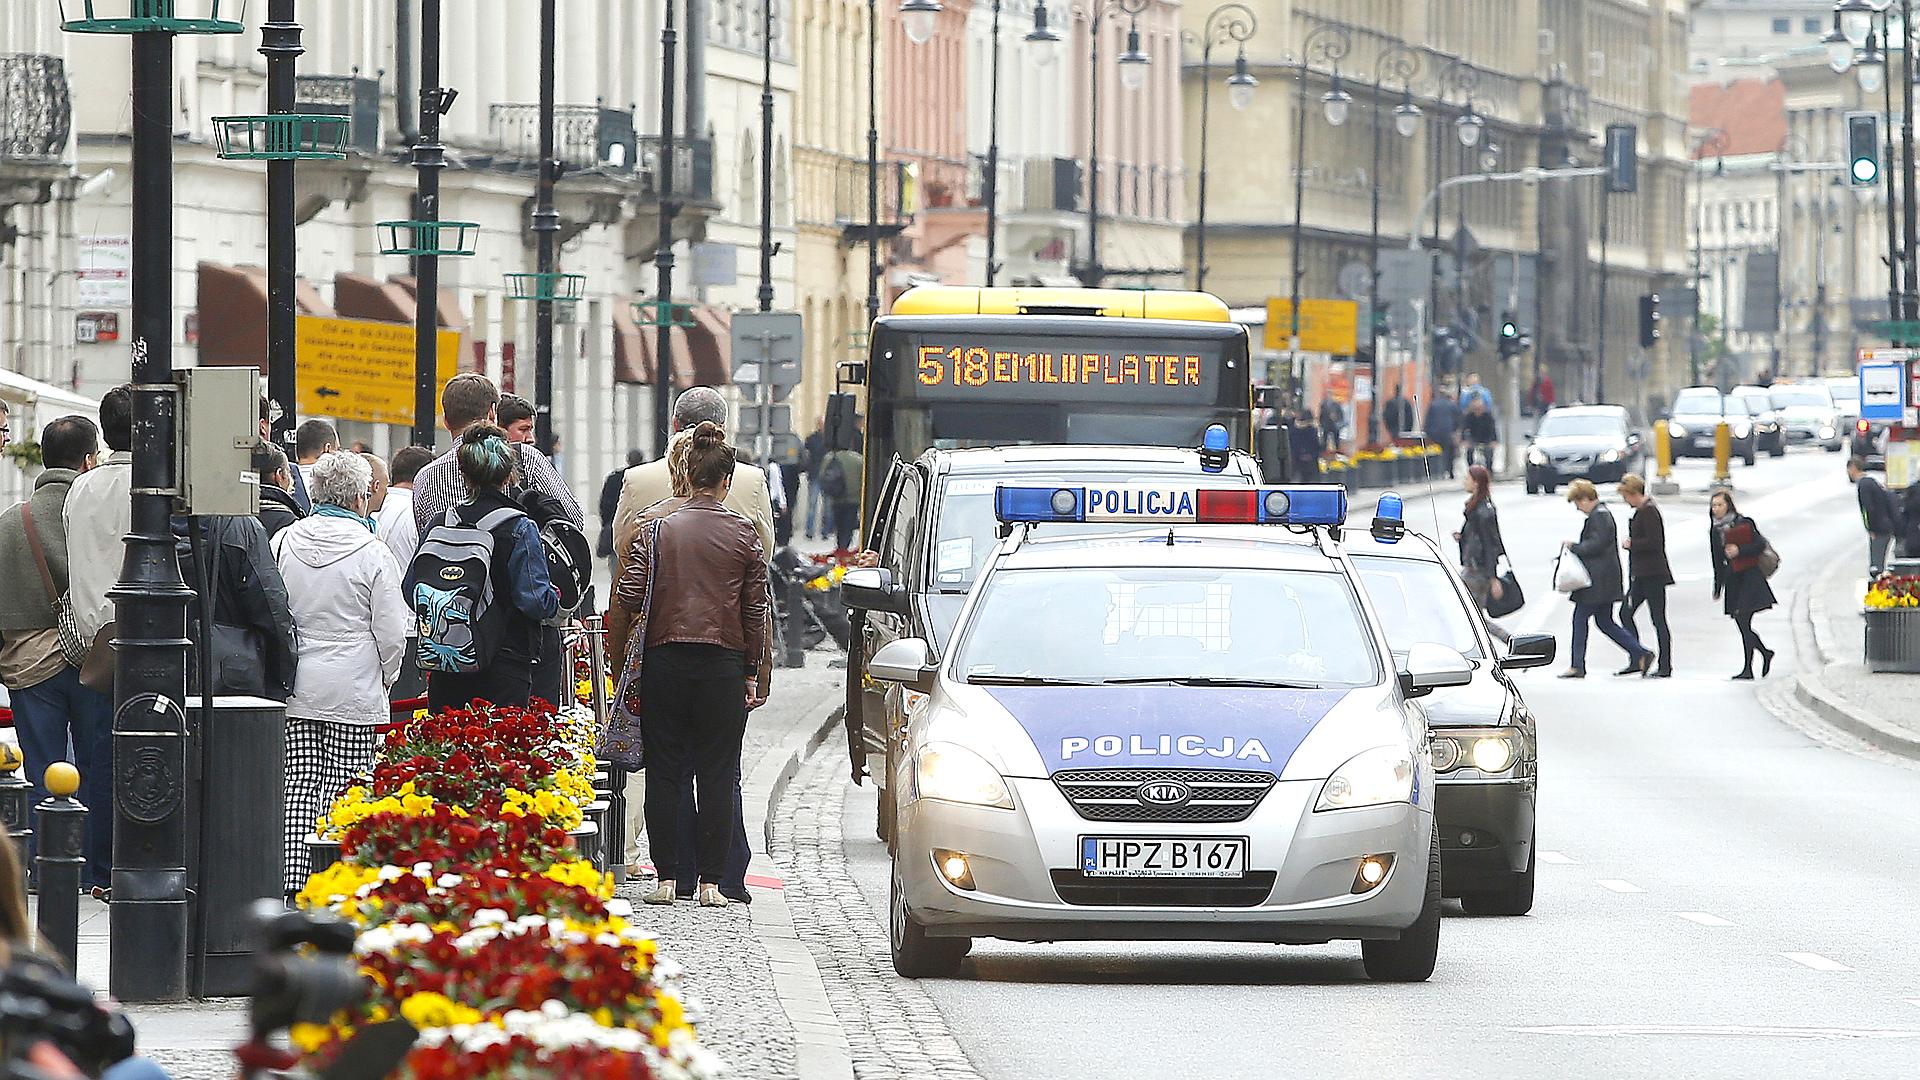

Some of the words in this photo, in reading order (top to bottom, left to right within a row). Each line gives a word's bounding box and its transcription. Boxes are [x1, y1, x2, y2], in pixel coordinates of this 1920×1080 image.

[918, 346, 990, 386] 518
[1089, 490, 1194, 515] POLICJA
[1060, 735, 1272, 763] POLICJA
[1149, 786, 1181, 799] KIA
[1085, 858, 1096, 867] PL
[1102, 842, 1162, 869] HPZ
[1172, 843, 1239, 870] B167
